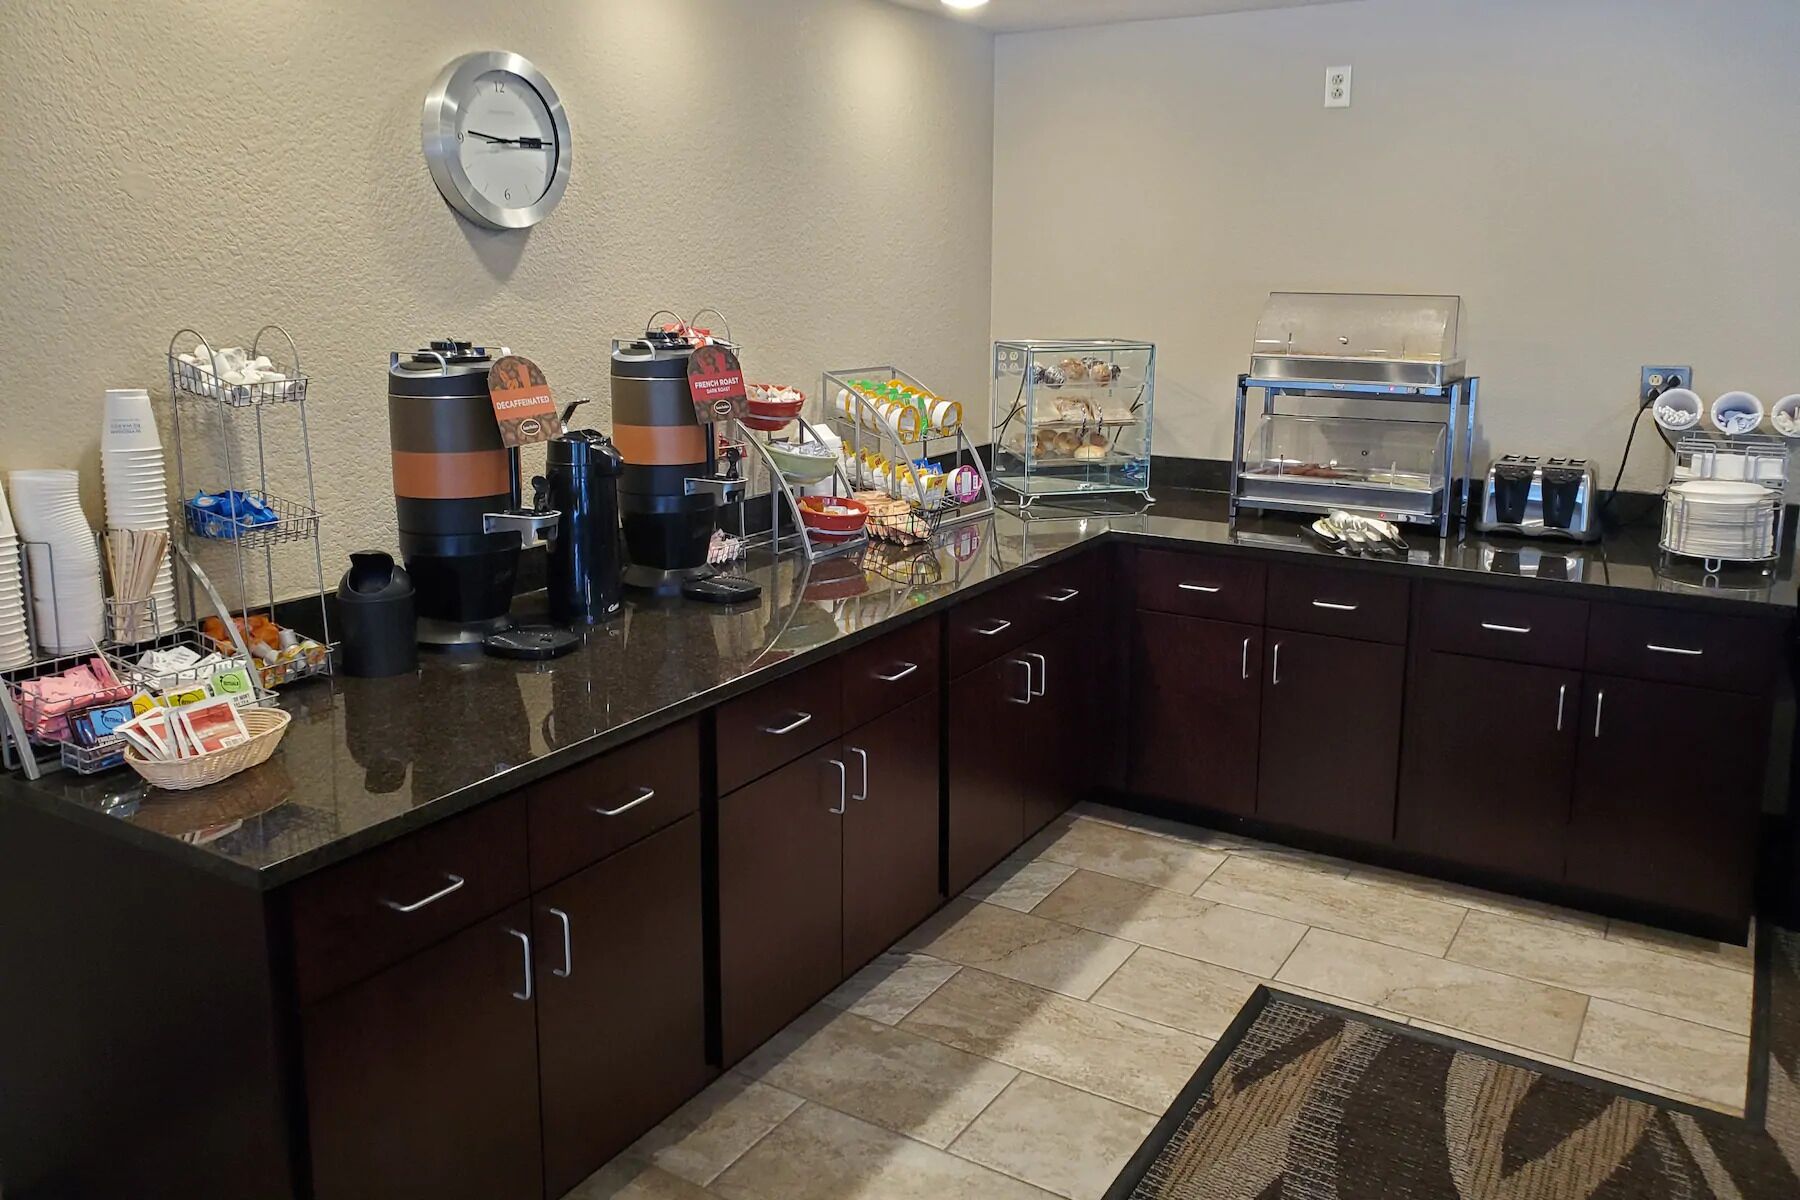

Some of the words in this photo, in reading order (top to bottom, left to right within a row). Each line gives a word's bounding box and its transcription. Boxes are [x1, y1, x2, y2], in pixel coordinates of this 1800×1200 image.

[494, 80, 505, 94] 12
[457, 132, 465, 144] 9
[504, 188, 511, 200] 6
[694, 379, 719, 389] FRENCH
[719, 377, 739, 386] ROAST
[496, 395, 550, 410] DECAFFEINATED
